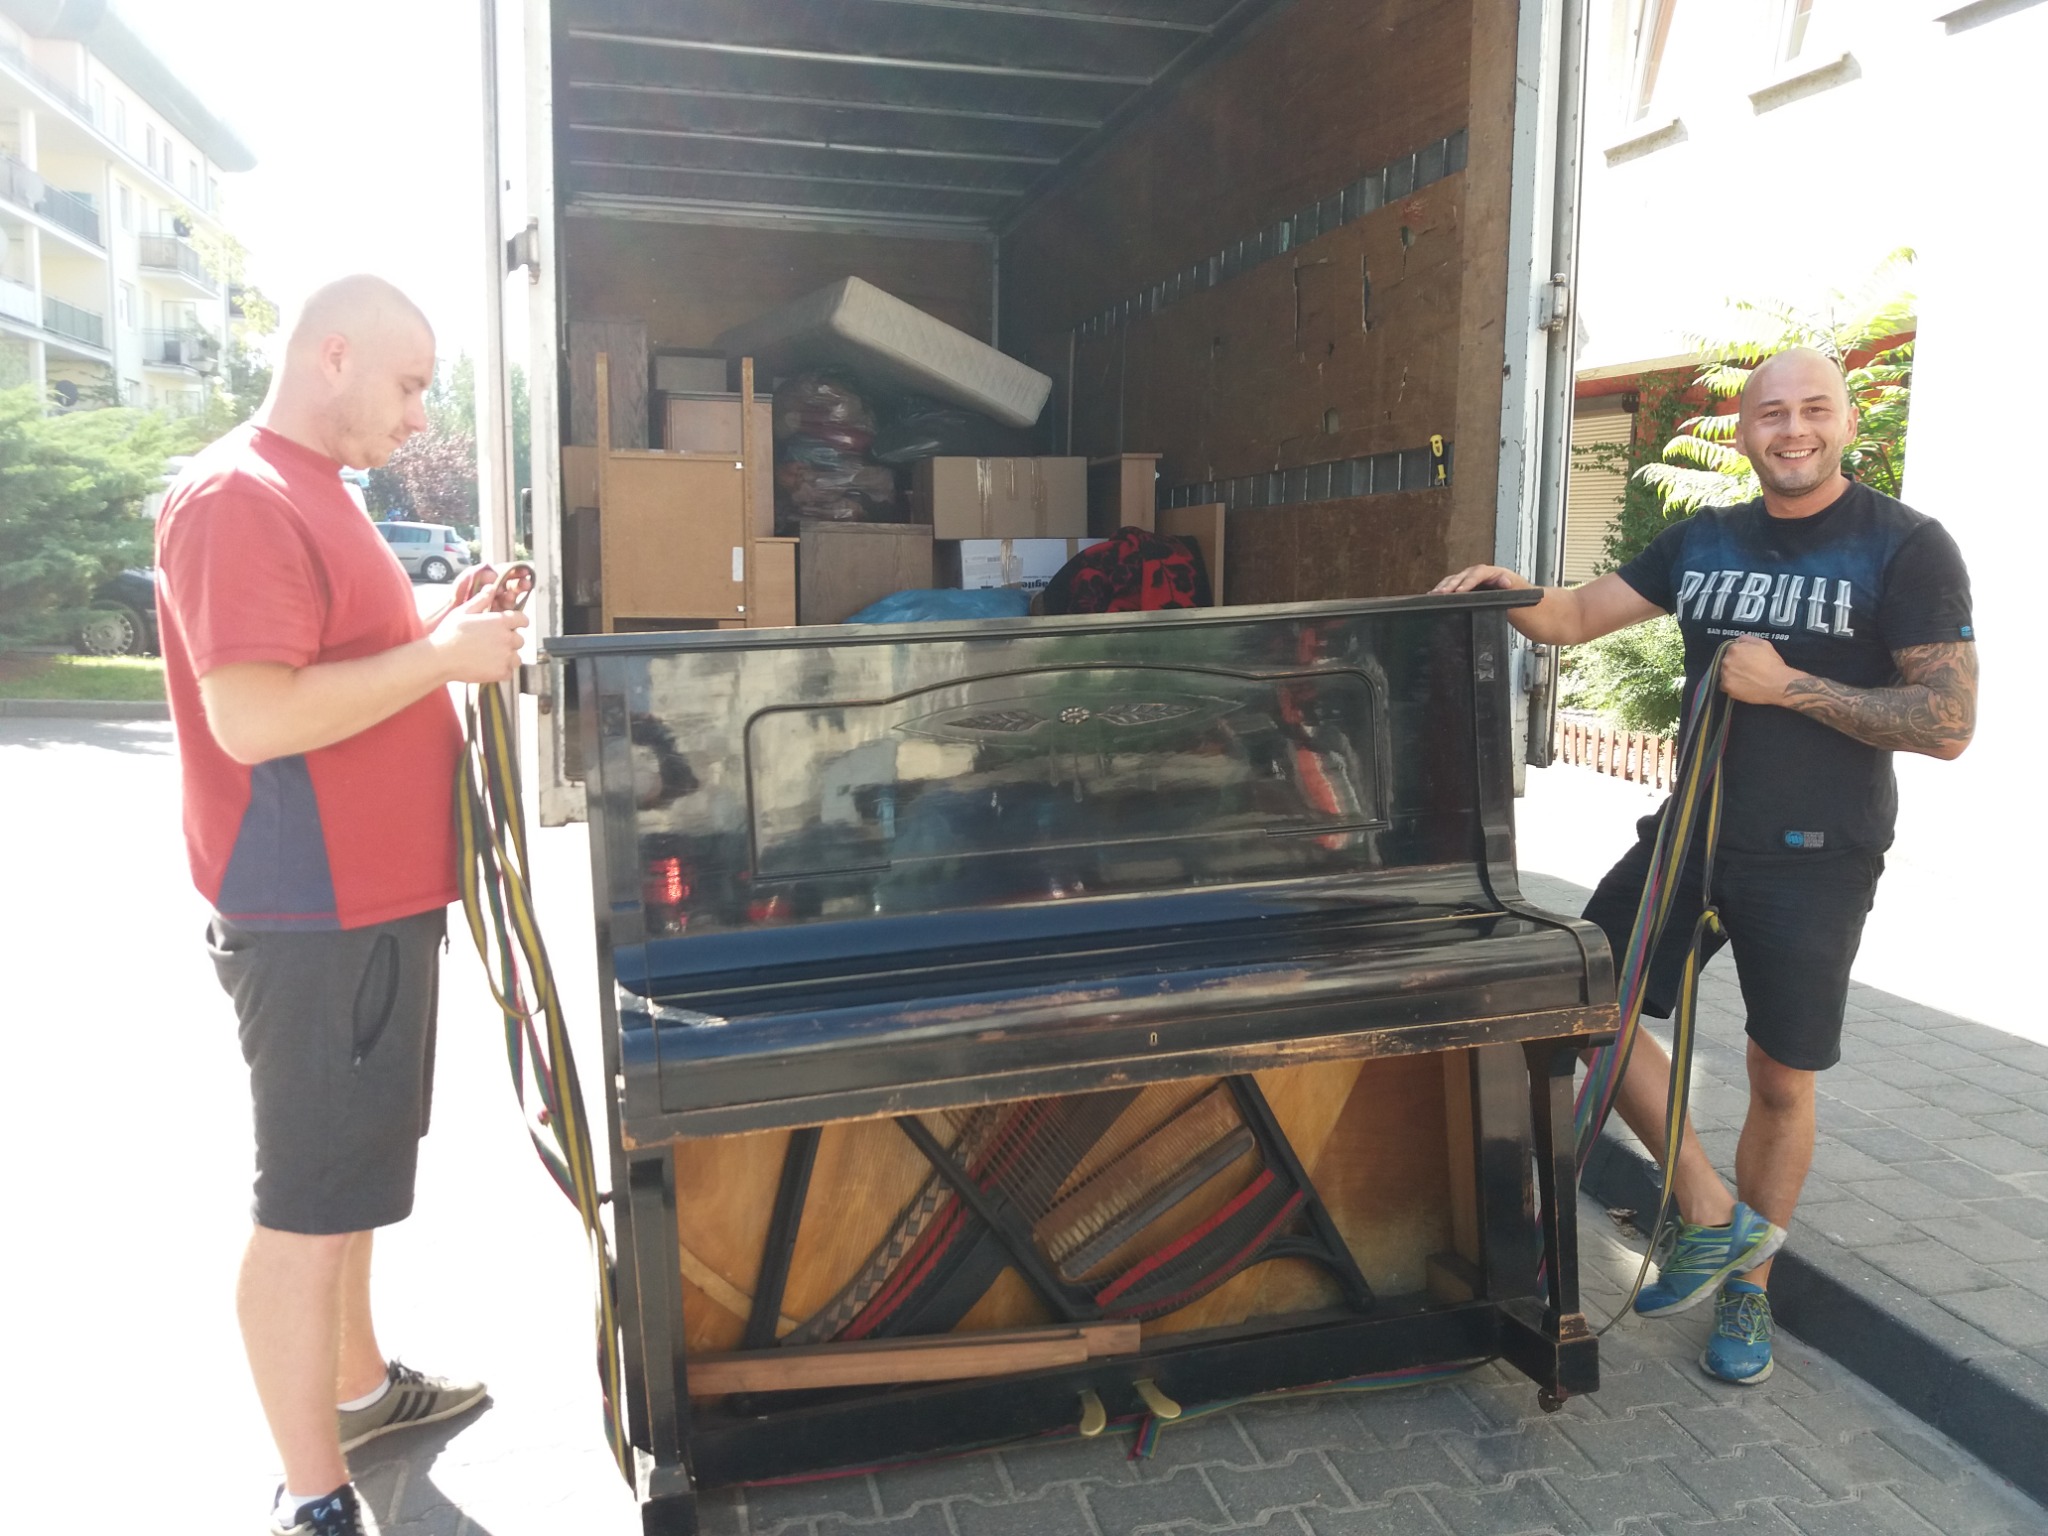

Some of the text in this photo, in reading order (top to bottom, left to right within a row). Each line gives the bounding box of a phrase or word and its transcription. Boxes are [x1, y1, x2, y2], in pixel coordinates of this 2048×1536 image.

[1676, 570, 1855, 637] PITBULL
[1722, 629, 1745, 637] DIEGO
[1771, 633, 1790, 641] 1989
